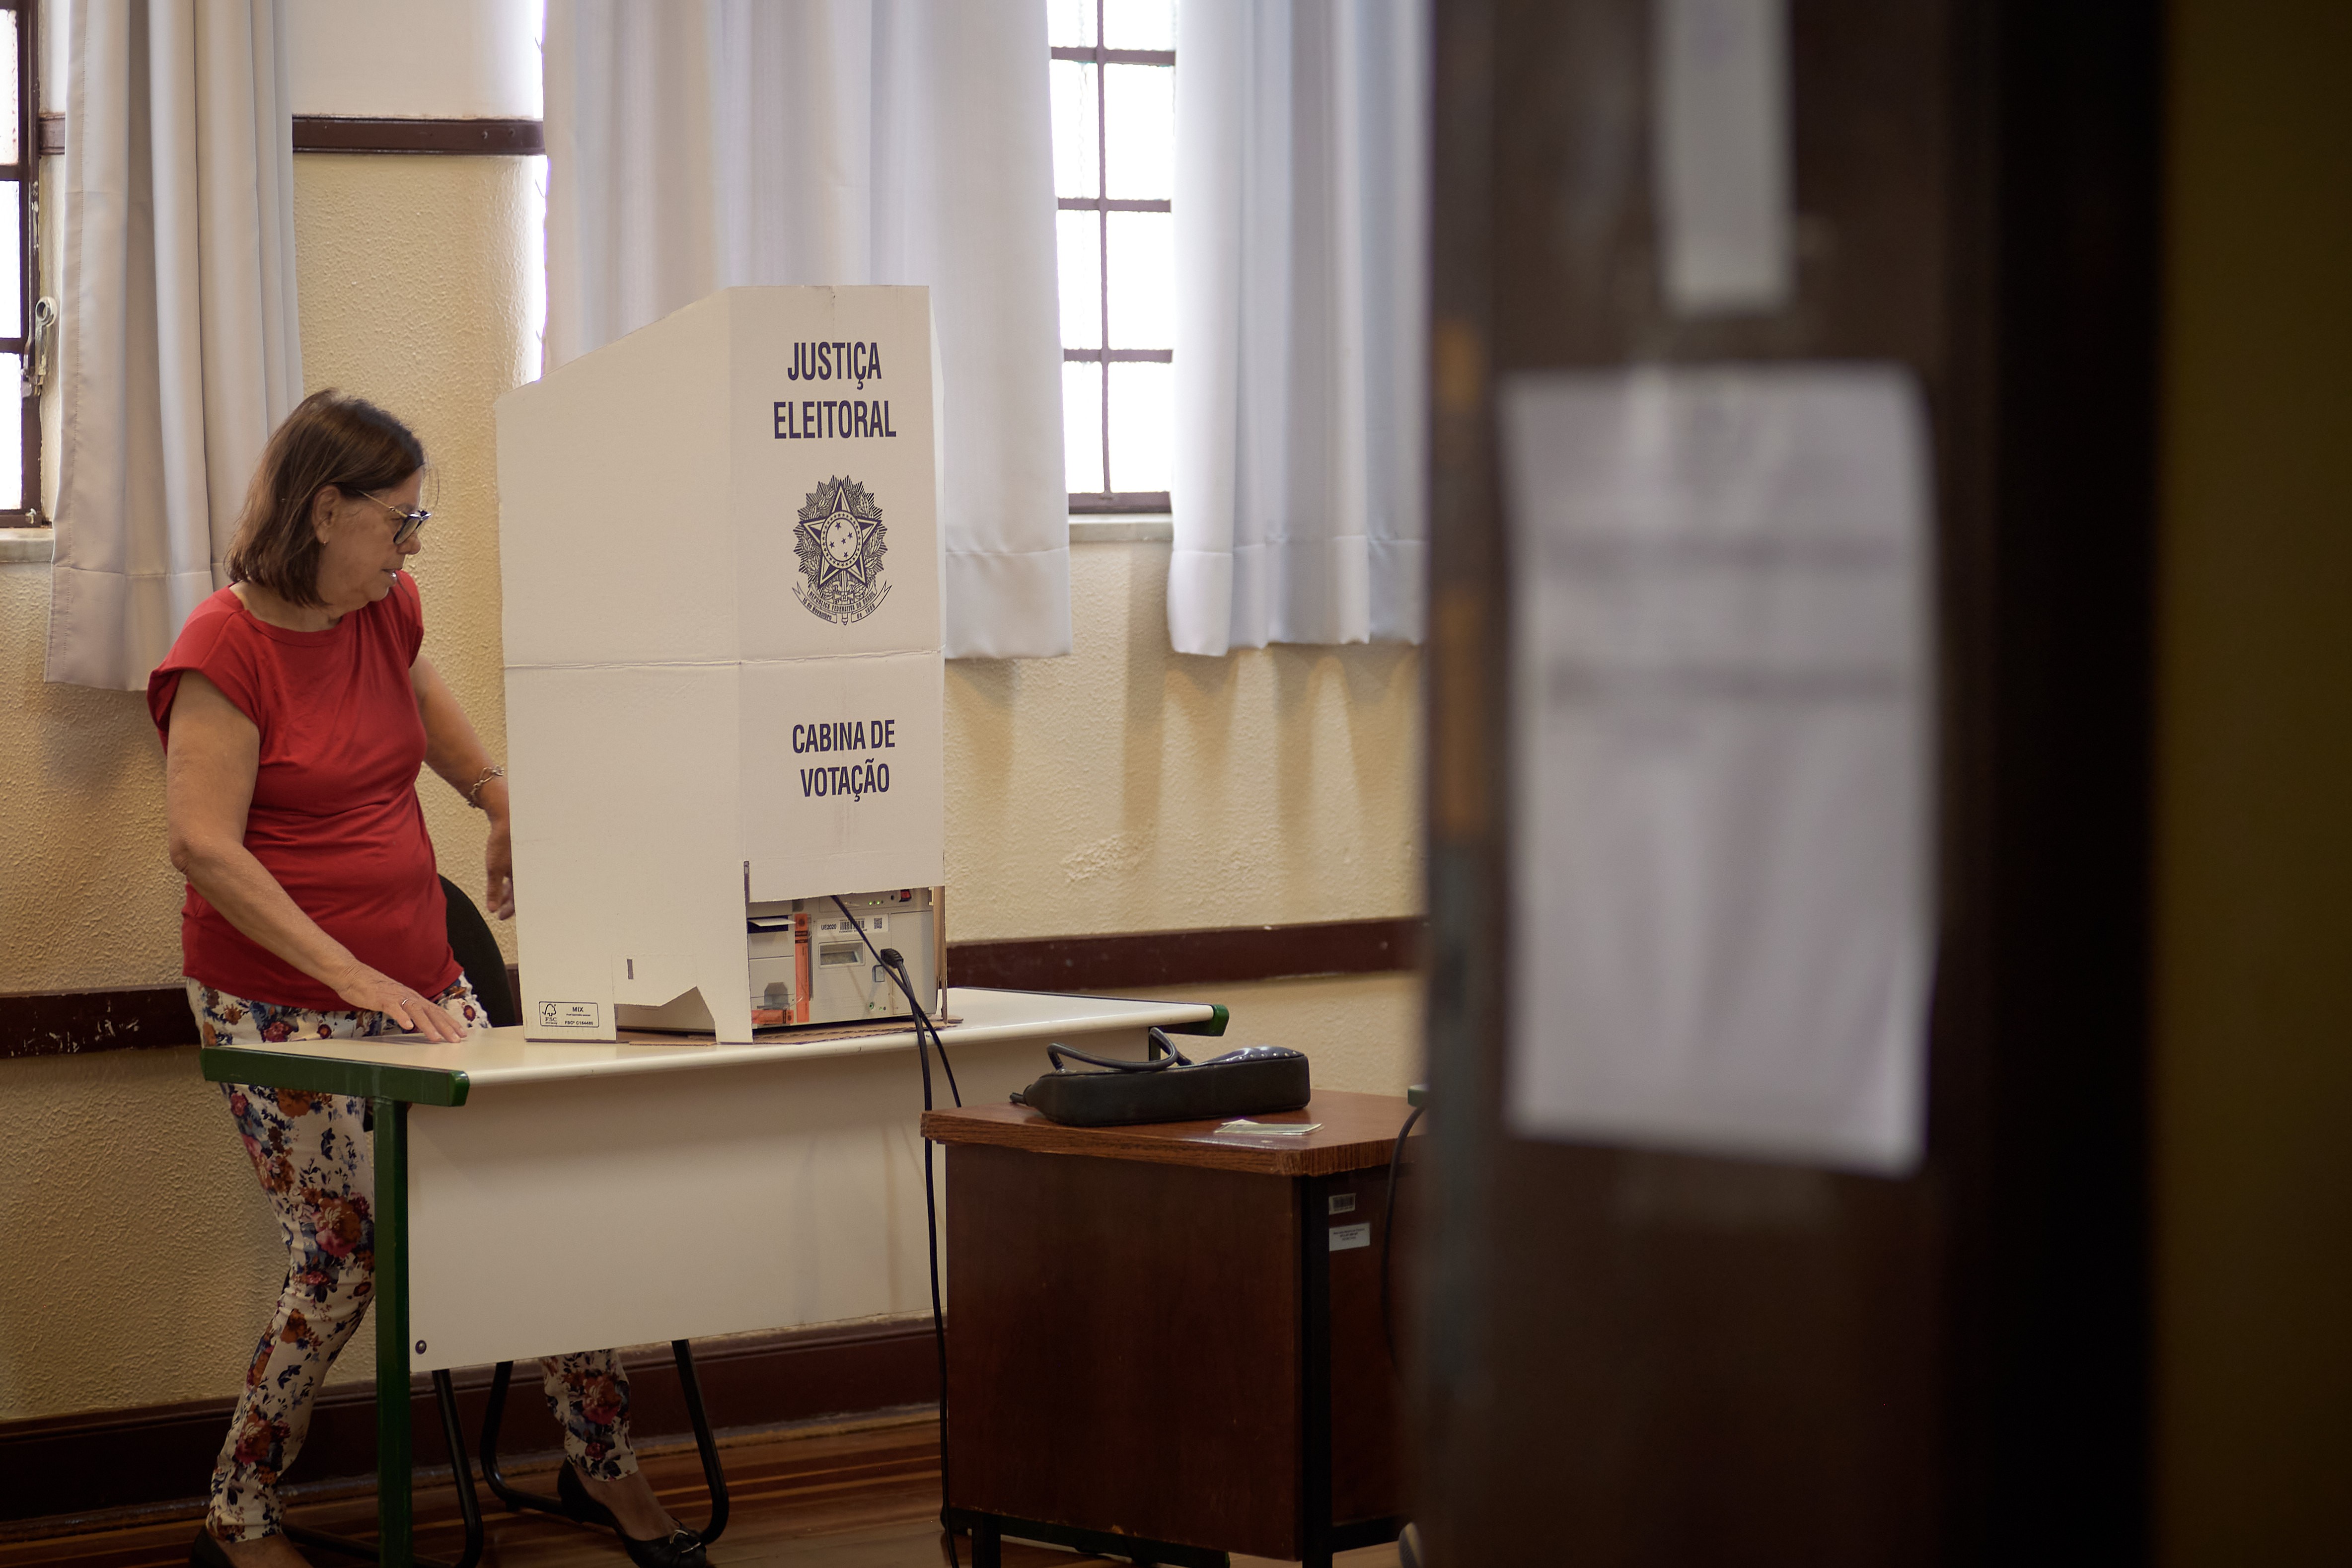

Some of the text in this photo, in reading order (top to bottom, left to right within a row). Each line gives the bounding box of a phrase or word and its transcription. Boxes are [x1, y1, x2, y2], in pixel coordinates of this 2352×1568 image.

[787, 341, 882, 390] JUSTIÇA
[774, 400, 896, 439] ELEITORAL
[793, 719, 895, 754] CABINA DE
[800, 758, 889, 802] VOTAÇÃO
